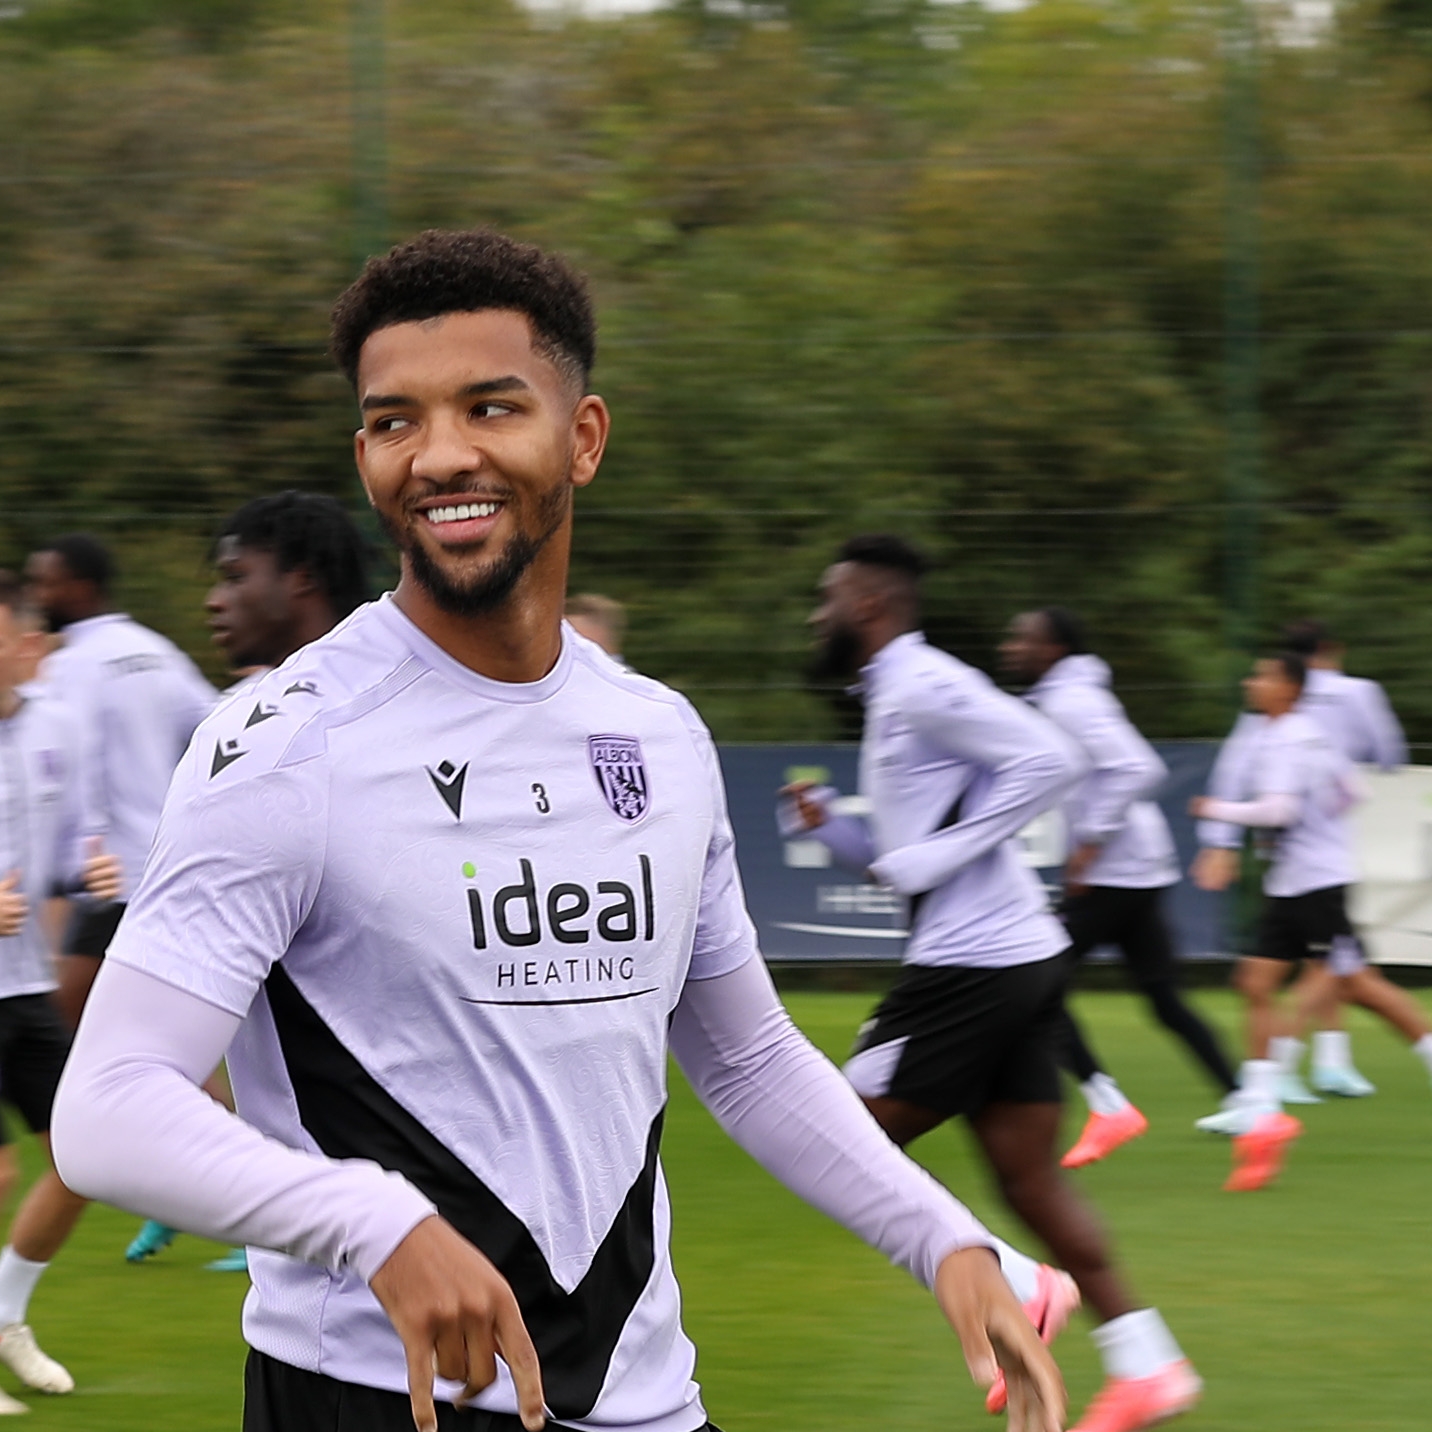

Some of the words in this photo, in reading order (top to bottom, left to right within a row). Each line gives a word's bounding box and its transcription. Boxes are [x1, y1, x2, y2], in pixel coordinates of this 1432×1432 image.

[531, 783, 551, 814] 3
[462, 854, 654, 950] ideal
[497, 957, 634, 988] HEATING
